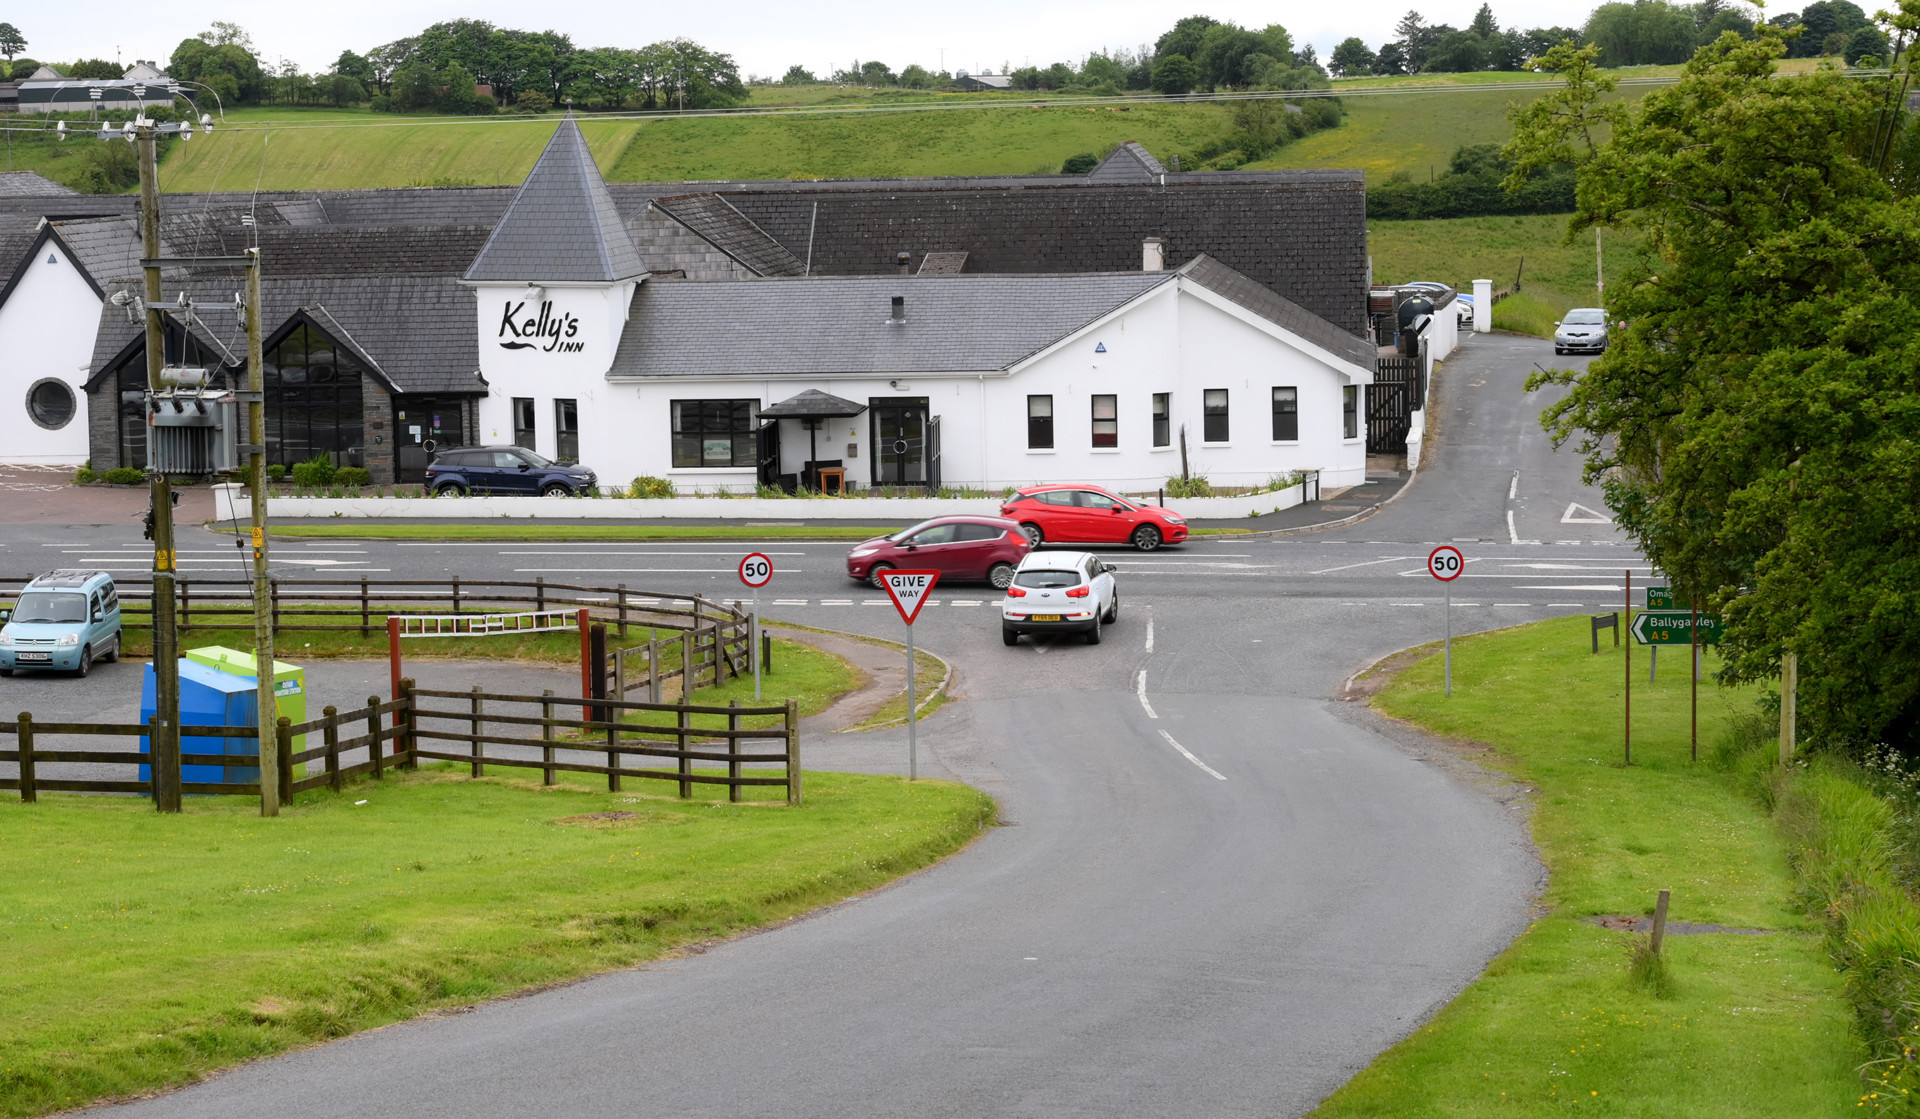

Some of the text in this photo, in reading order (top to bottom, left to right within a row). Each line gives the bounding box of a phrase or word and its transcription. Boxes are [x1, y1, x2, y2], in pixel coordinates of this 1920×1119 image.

[499, 300, 579, 352] Kelly's
[557, 341, 585, 352] INN
[745, 562, 768, 577] 50
[1434, 556, 1459, 571] 50
[891, 576, 925, 587] GIVE
[1649, 589, 1673, 599] Omag
